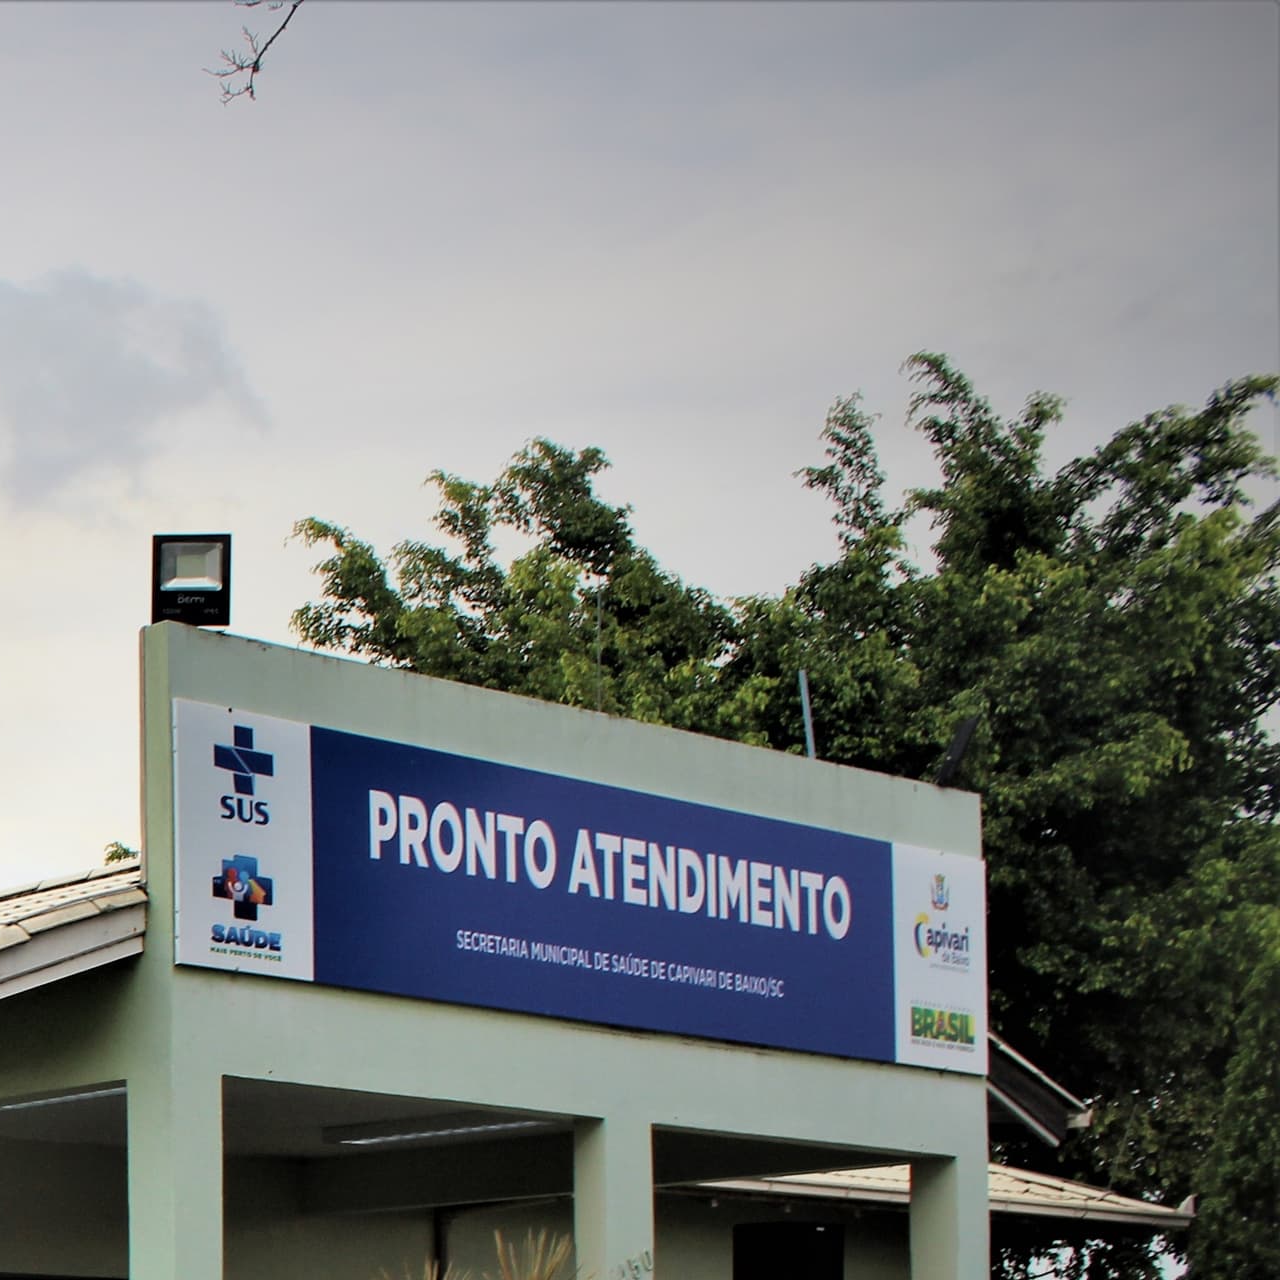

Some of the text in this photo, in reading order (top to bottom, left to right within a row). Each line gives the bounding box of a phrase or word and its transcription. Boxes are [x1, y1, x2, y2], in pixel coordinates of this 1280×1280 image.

[220, 795, 270, 826] SUS
[368, 788, 852, 941] PRONTO ATENDIMENTO
[211, 923, 281, 951] SAÚDE
[914, 912, 969, 957] Capivari
[456, 929, 785, 999] SECRETARIA MUNICIPAL DE SAÚDE DE CAPIVARI DE BAIXO/SC
[911, 1006, 975, 1045] BRASIL
